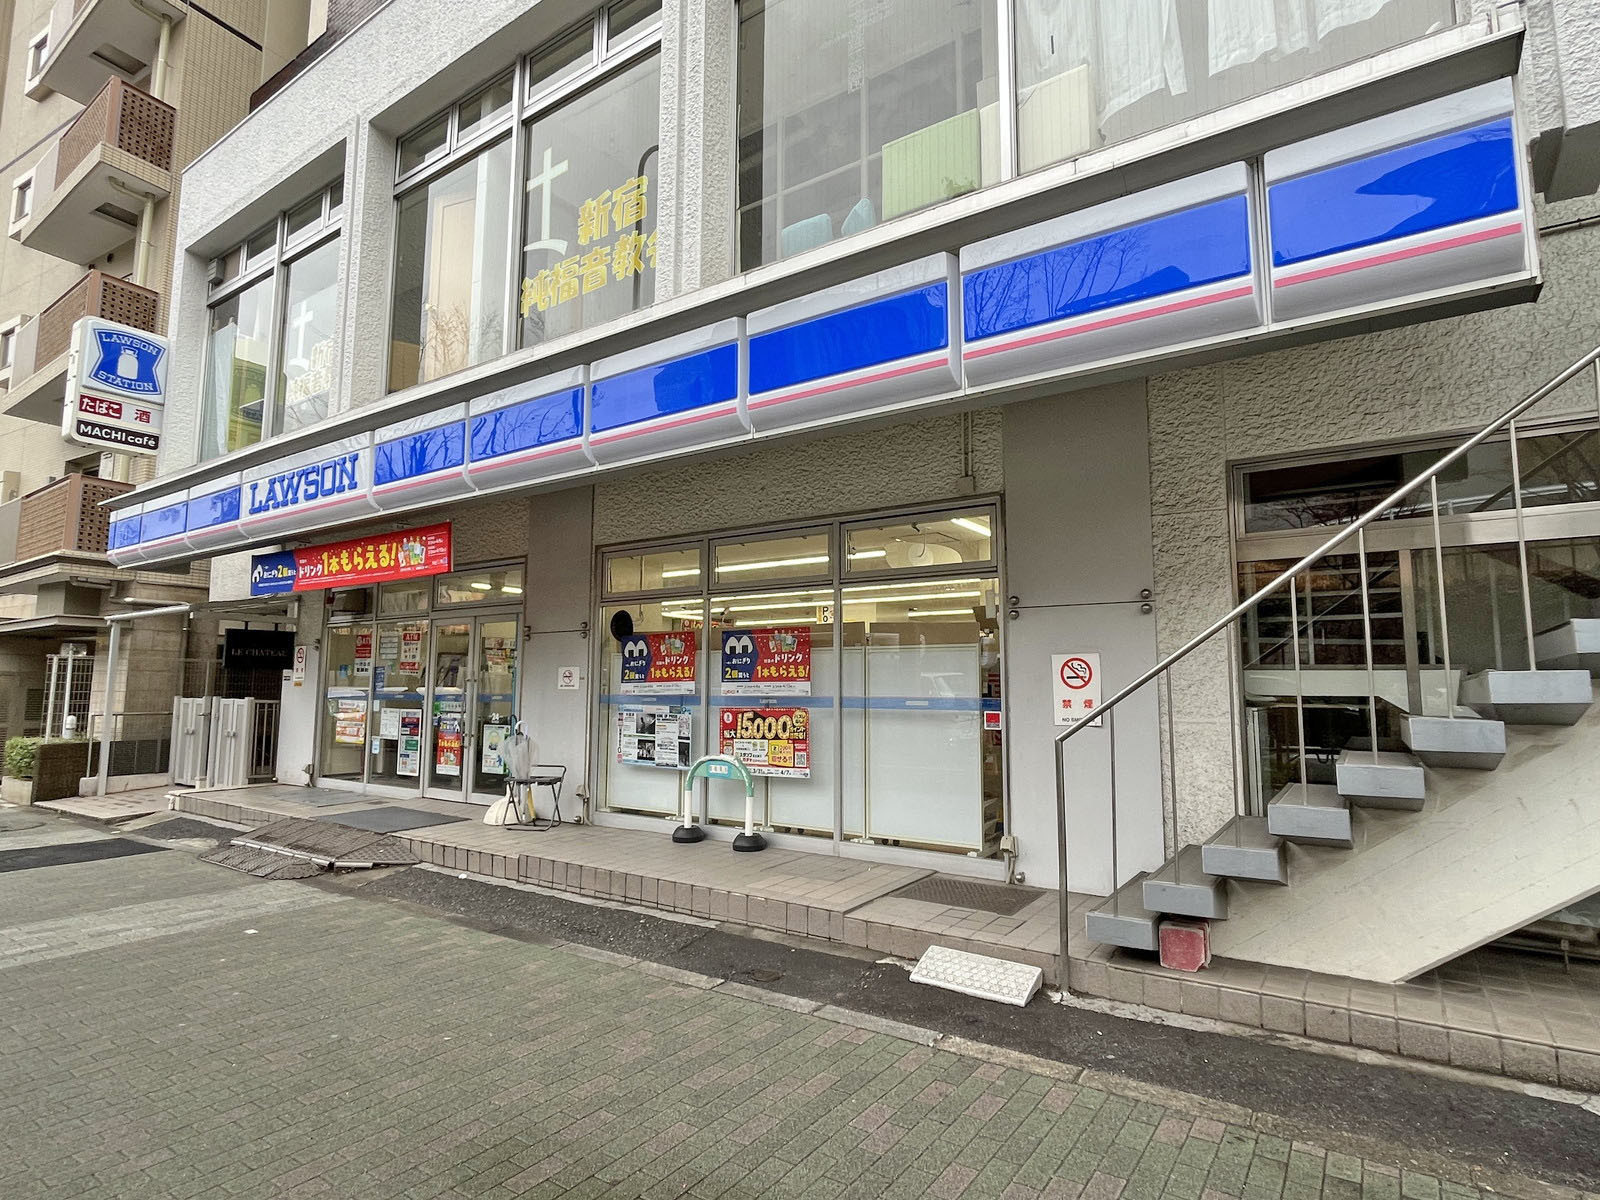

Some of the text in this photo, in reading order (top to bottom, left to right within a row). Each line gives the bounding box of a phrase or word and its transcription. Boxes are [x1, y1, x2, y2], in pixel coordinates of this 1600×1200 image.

[577, 174, 649, 246] 新宿
[101, 332, 160, 357] LAWSON
[97, 369, 154, 391] STATION
[81, 397, 152, 424] たばこ 酒
[79, 423, 156, 447] MACHI café
[249, 452, 359, 515] LAWSON
[405, 633, 419, 641] ATM
[774, 653, 803, 664] ドリンク
[756, 664, 809, 678] 1本もらえる!
